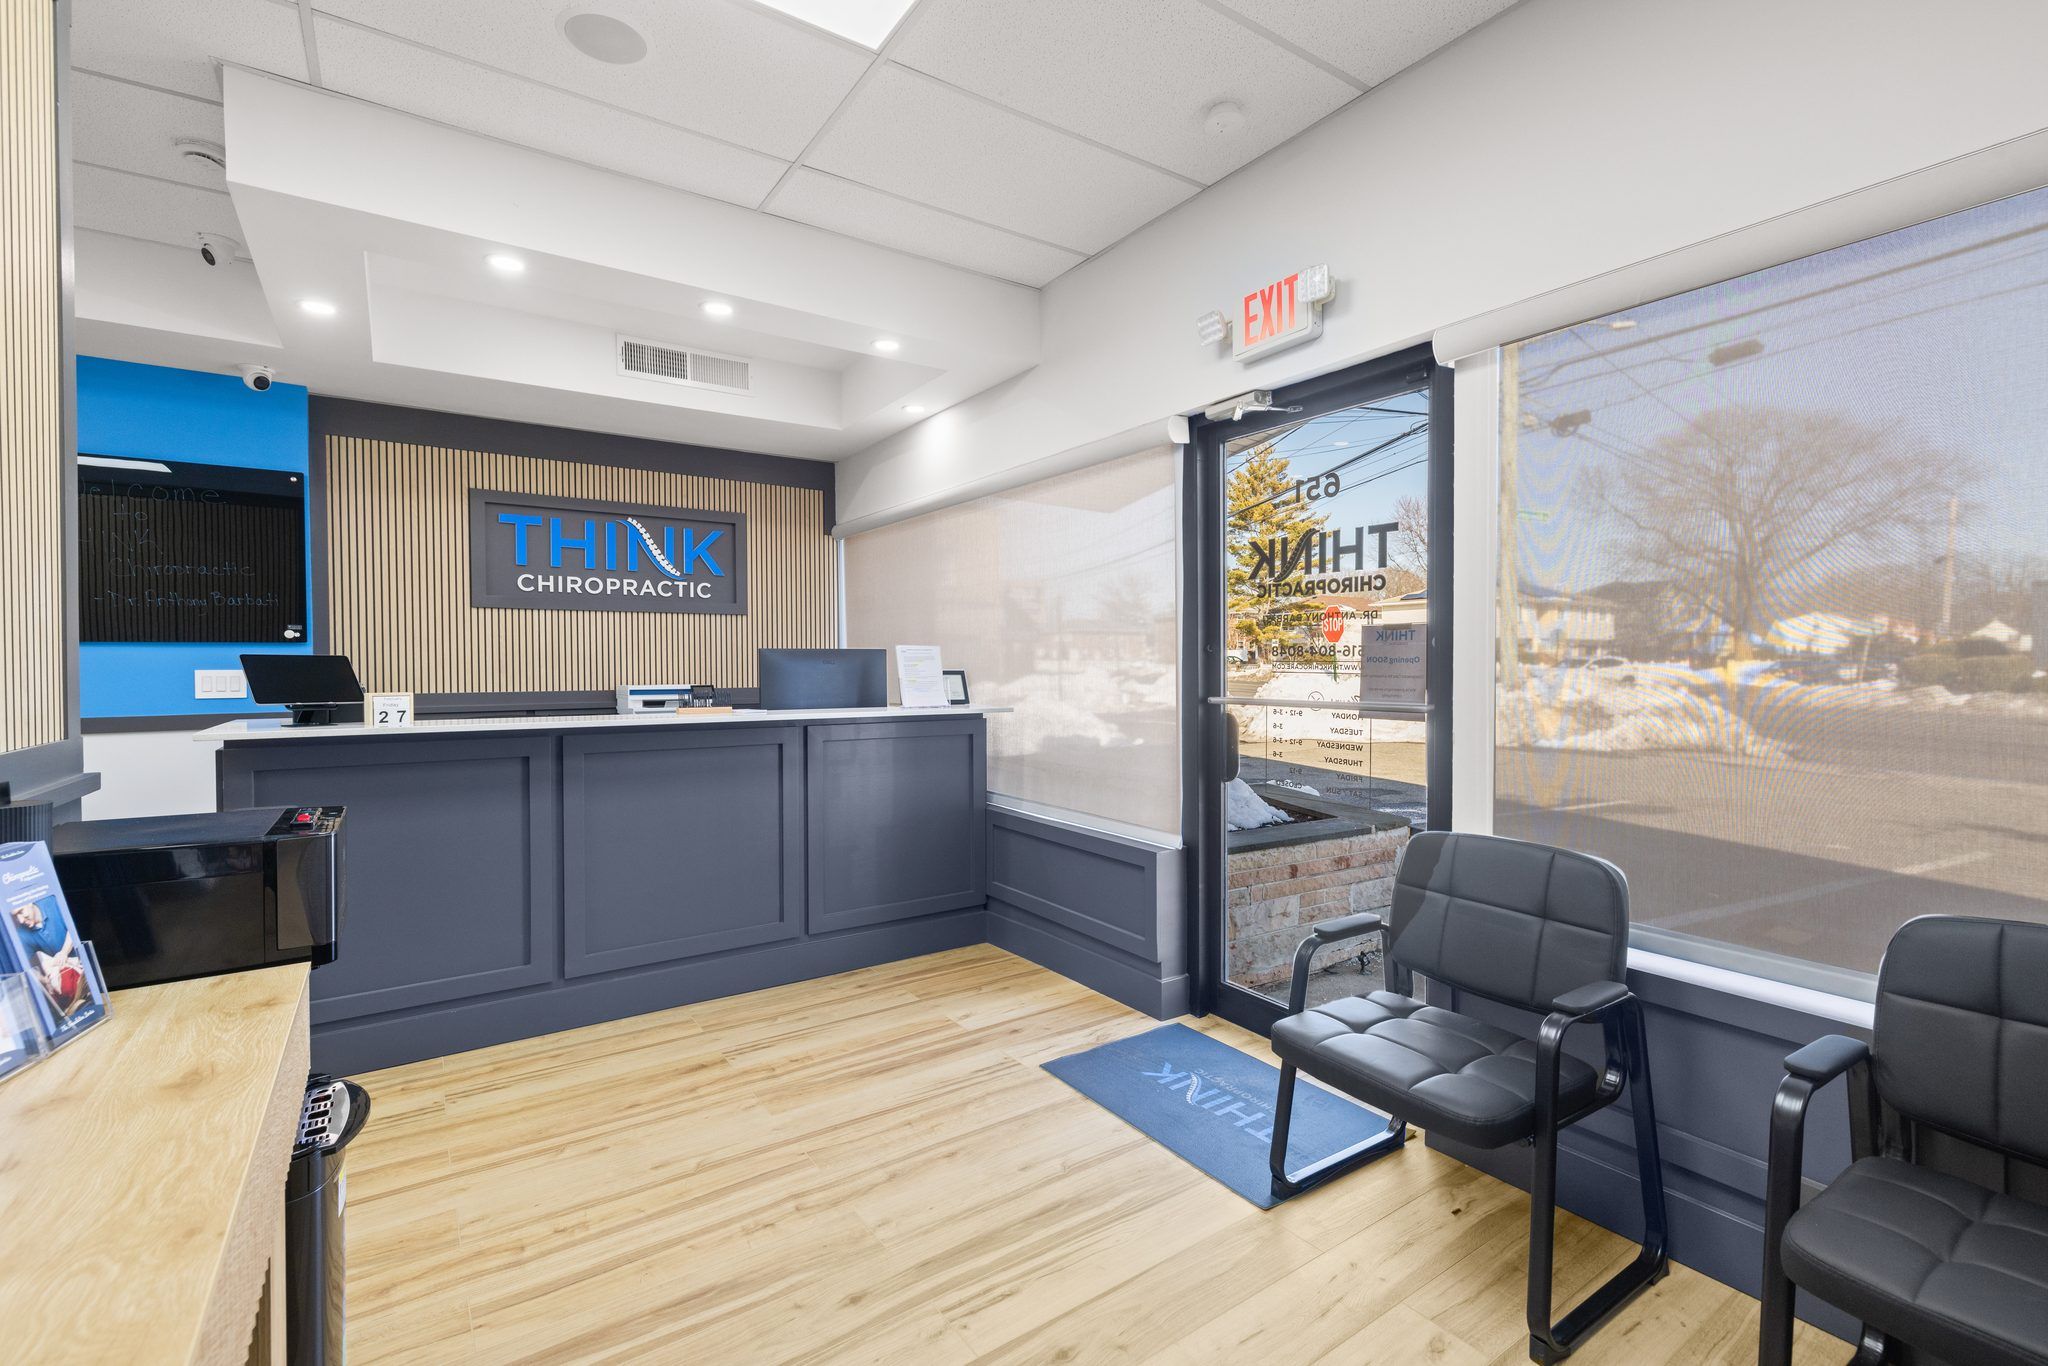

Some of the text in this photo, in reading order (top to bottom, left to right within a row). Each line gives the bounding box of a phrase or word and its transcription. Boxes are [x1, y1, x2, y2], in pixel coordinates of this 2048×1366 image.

[1244, 273, 1298, 346] EXIT
[498, 513, 725, 580] THINK
[517, 573, 712, 599] CHIROPRACTIC
[1322, 617, 1344, 632] STOP
